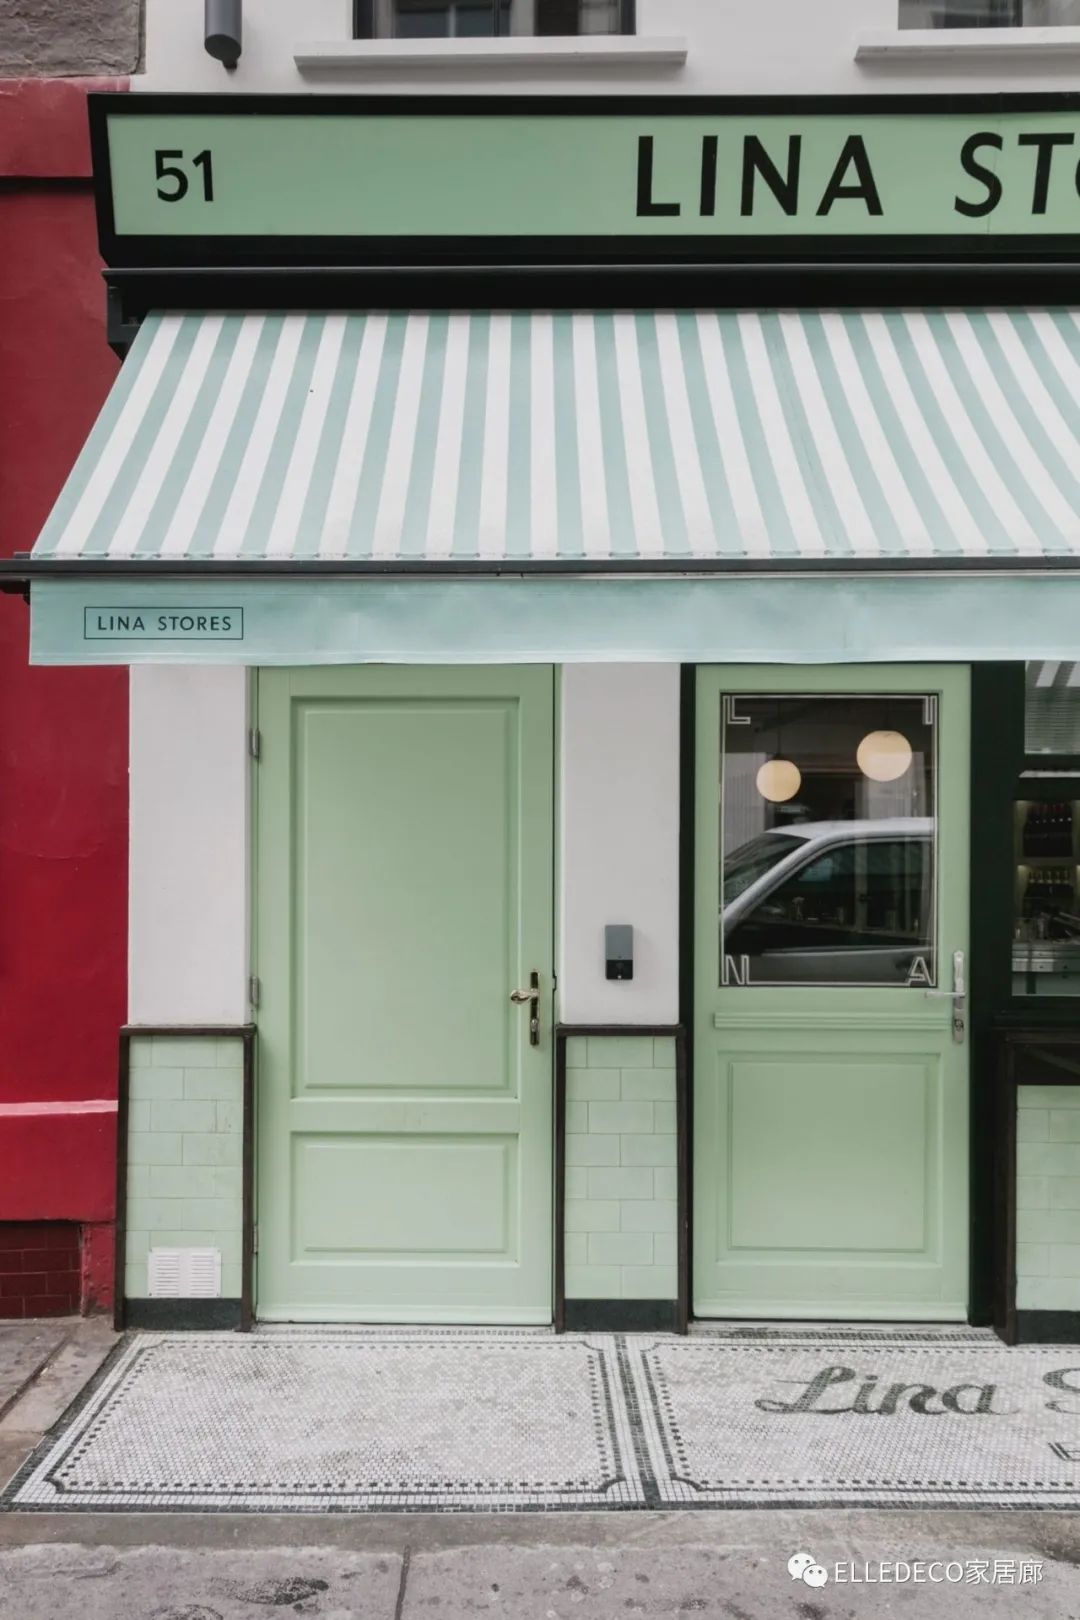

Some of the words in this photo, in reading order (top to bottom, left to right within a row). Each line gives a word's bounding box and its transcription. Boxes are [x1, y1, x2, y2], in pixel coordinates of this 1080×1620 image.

[155, 150, 214, 202] 51
[636, 134, 884, 217] LINA
[954, 131, 1080, 218] ST
[97, 615, 146, 632] LINA
[157, 615, 232, 632] STORES
[754, 1366, 1020, 1415] Lina
